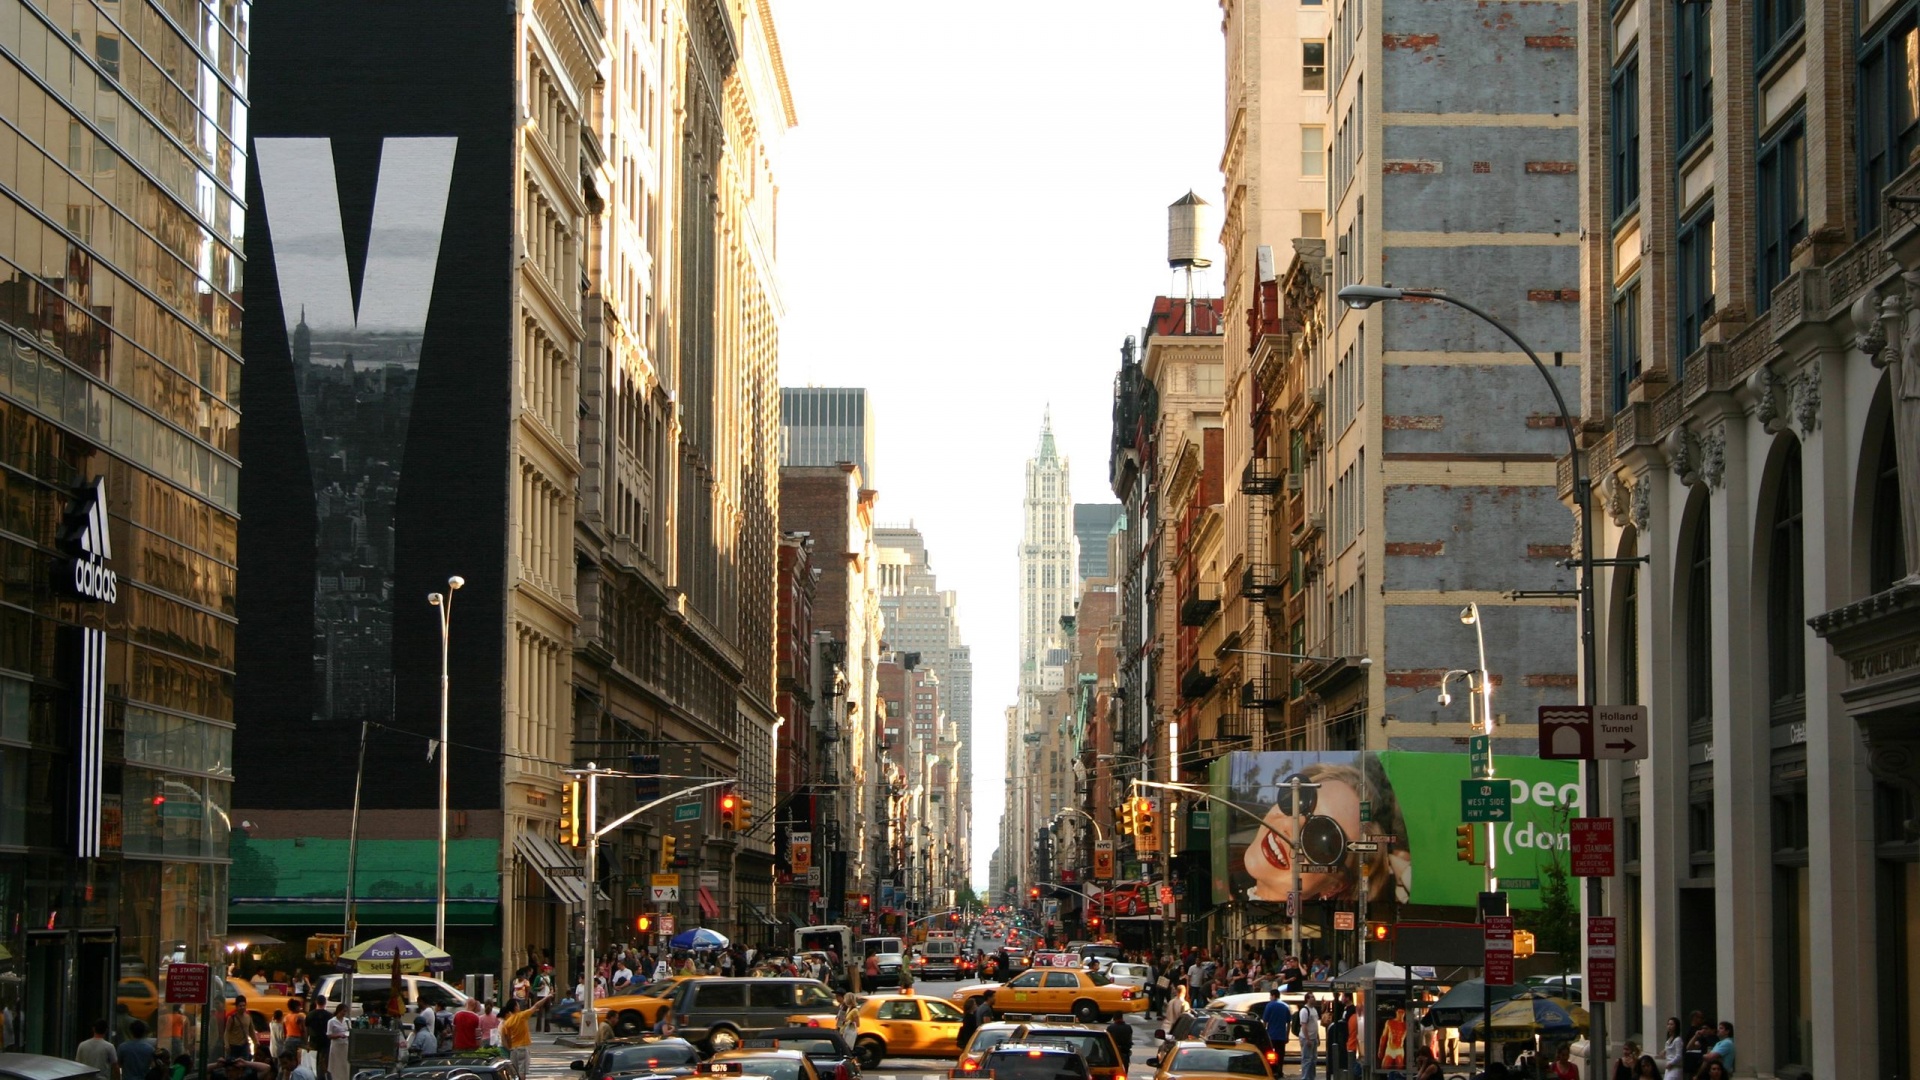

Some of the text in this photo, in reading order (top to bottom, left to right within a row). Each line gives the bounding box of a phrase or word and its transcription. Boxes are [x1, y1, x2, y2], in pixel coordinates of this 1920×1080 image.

[75, 552, 117, 604] adidas
[1599, 711, 1638, 721] Holland
[1601, 724, 1633, 733] Tunnel
[1467, 798, 1504, 806] WEST SIDE
[1467, 809, 1483, 817] HWY
[1572, 821, 1612, 831] SNOW ROUTE
[1572, 844, 1612, 853] NO STANDING
[546, 868, 583, 876] E HOUSTON ST
[1501, 880, 1531, 888] HOUSTON
[371, 949, 413, 957] Foxtns
